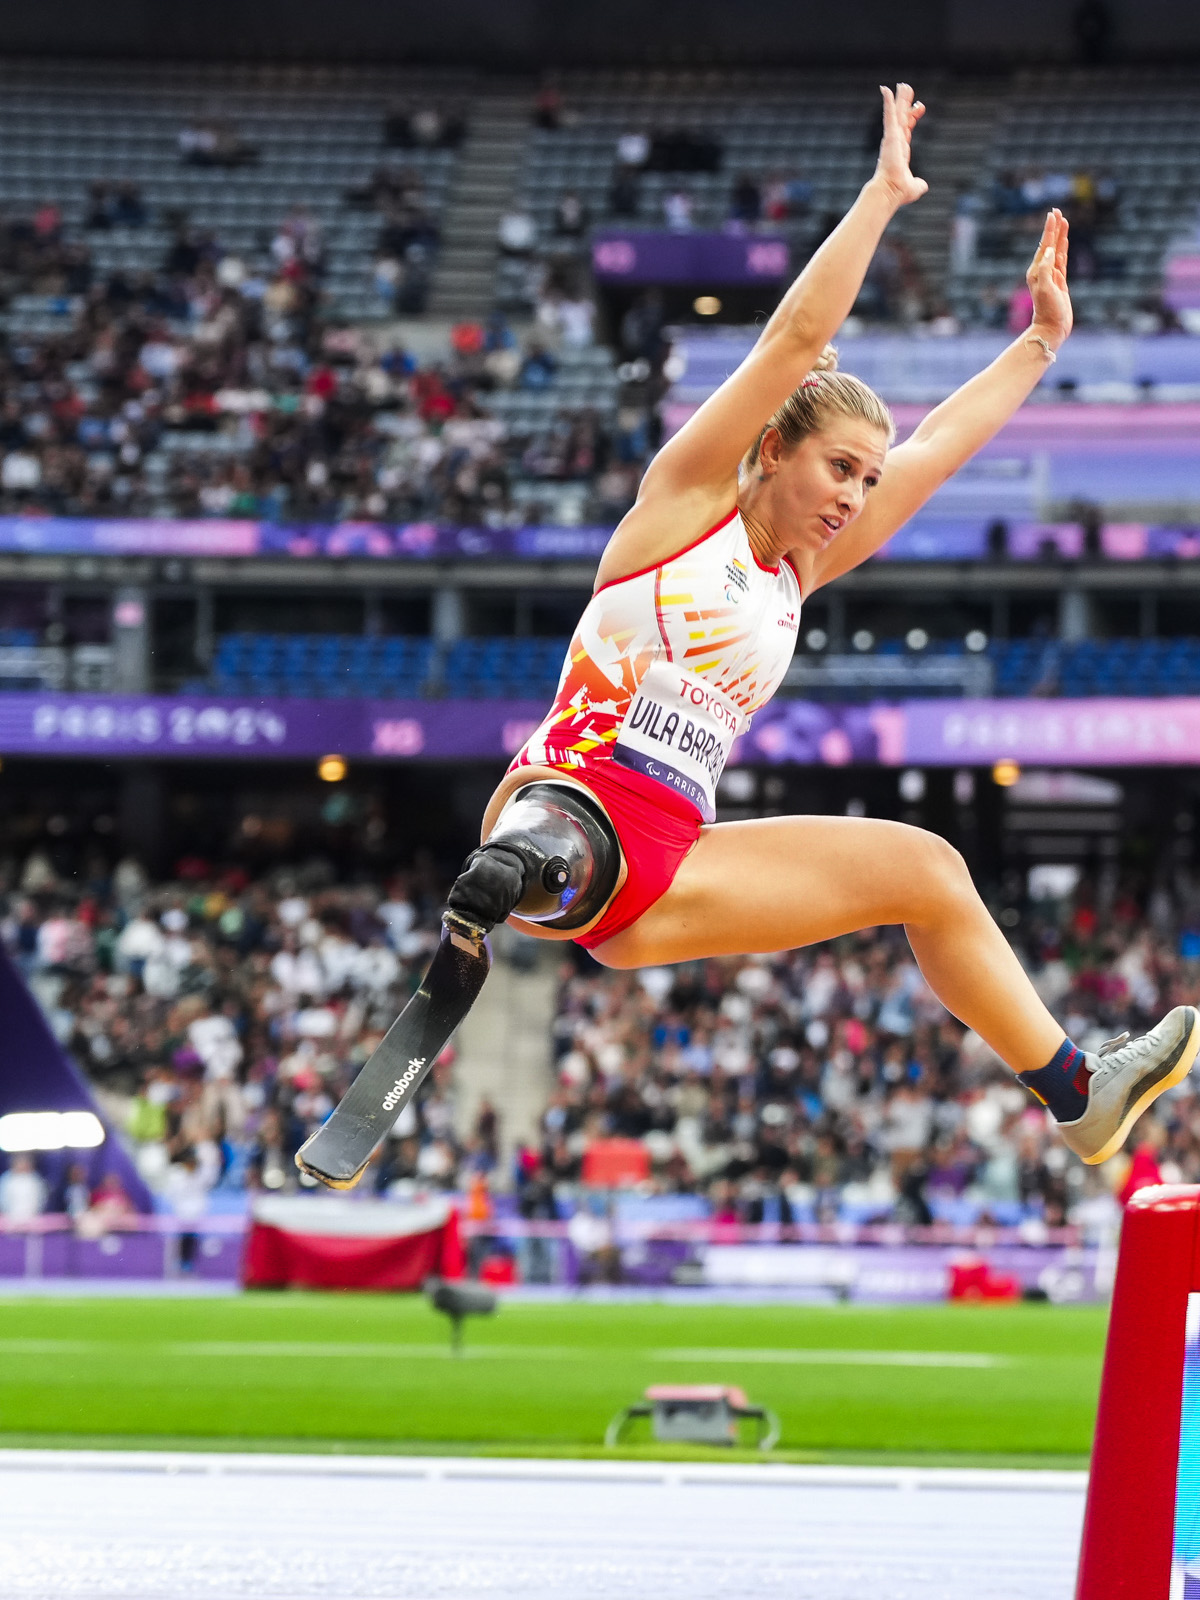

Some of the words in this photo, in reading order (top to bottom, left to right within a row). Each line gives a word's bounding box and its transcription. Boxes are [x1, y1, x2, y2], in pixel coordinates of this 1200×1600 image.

[628, 695, 680, 745] VILA
[679, 678, 737, 736] TOYOTA
[666, 771, 696, 797] PARIS
[382, 1057, 427, 1111] ottobock.
